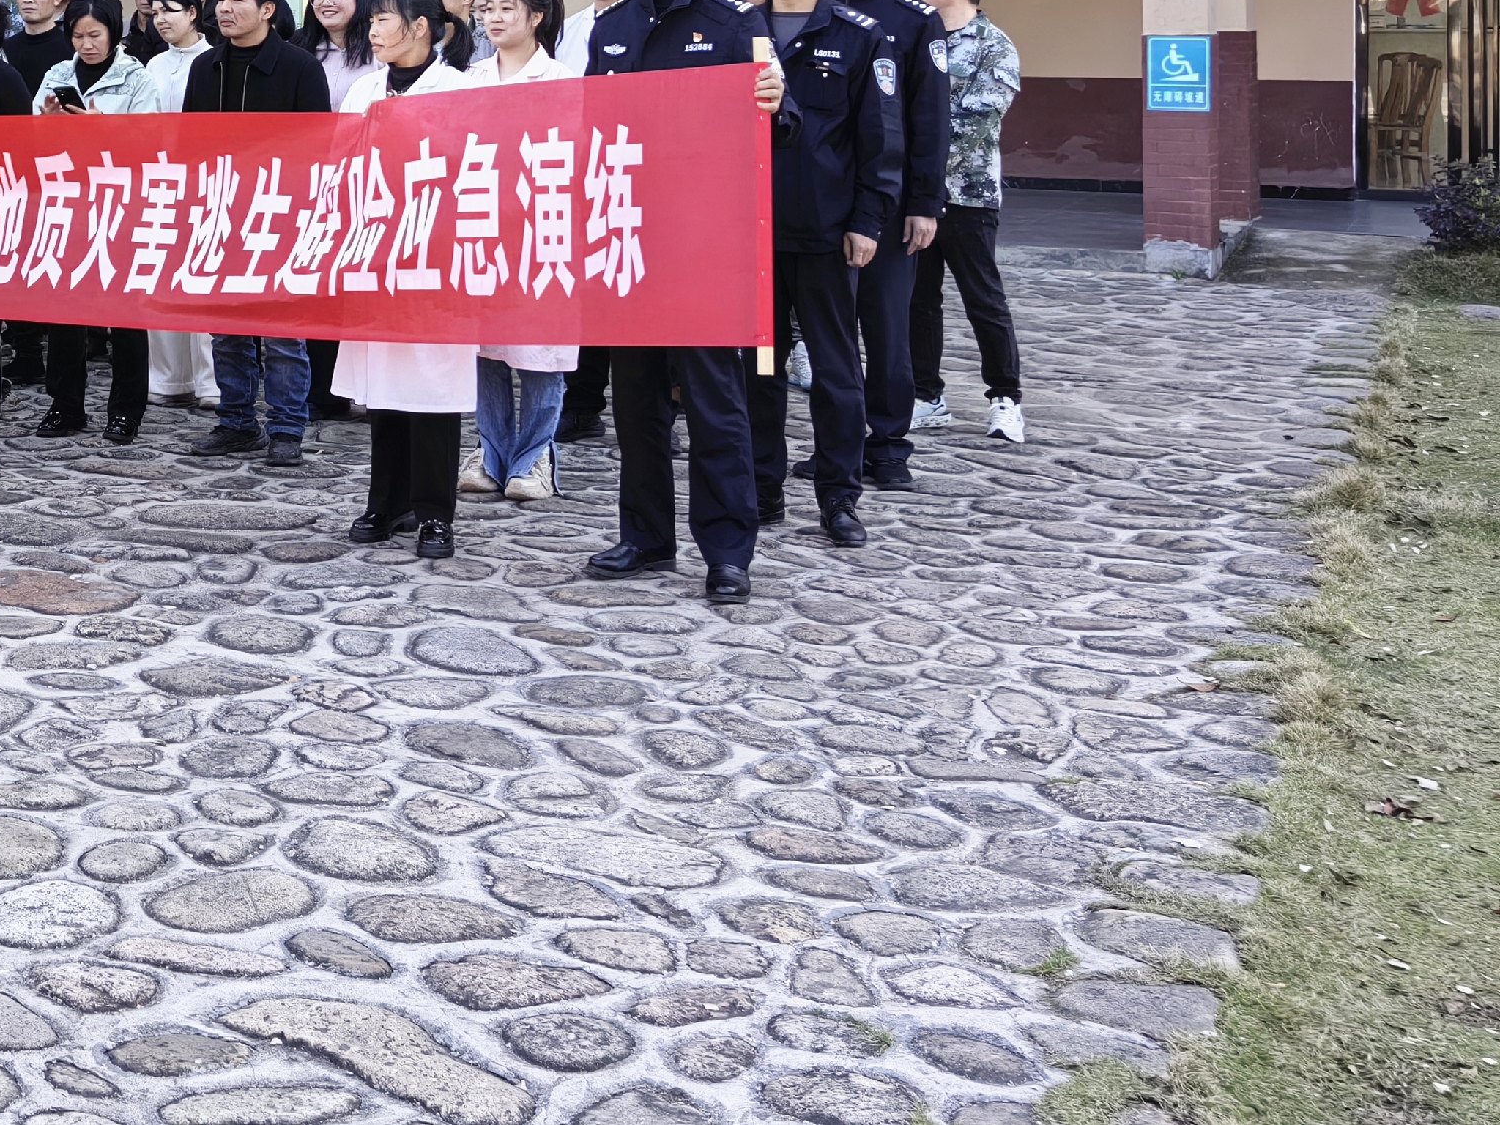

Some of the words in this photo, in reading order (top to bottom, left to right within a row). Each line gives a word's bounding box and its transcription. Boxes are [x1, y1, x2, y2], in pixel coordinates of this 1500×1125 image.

[1152, 89, 1205, 104] 无障碍坡道
